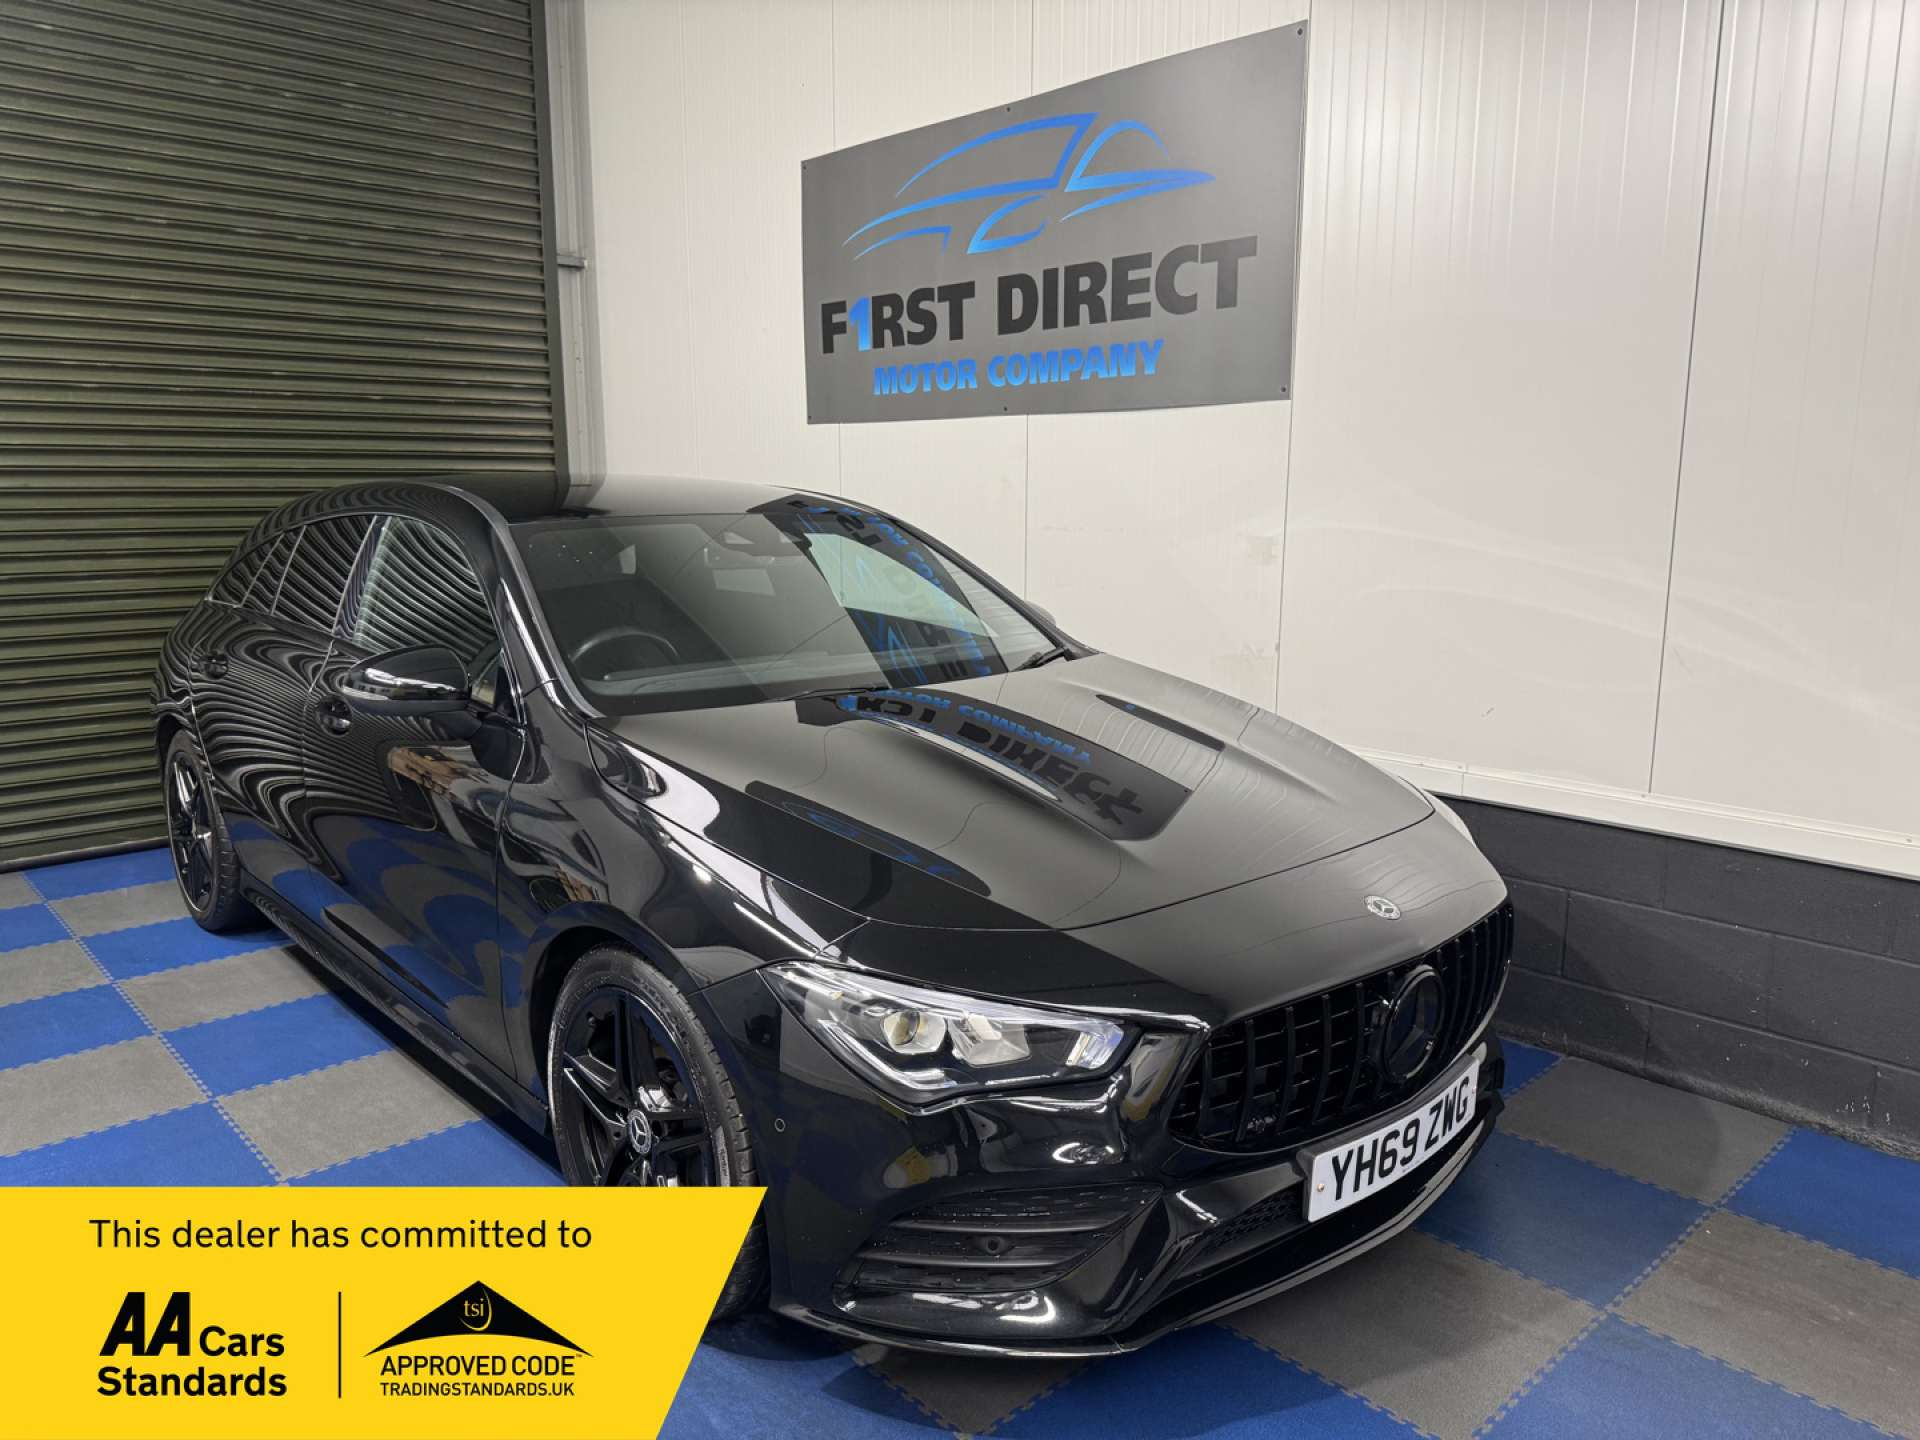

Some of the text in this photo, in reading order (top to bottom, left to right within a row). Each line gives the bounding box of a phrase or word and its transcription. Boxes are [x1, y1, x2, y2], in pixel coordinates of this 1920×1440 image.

[821, 236, 1258, 354] F1RST DIRECT
[873, 339, 1165, 396] MOTOR COMPANY
[1331, 1075, 1470, 1201] YH69 ZWG
